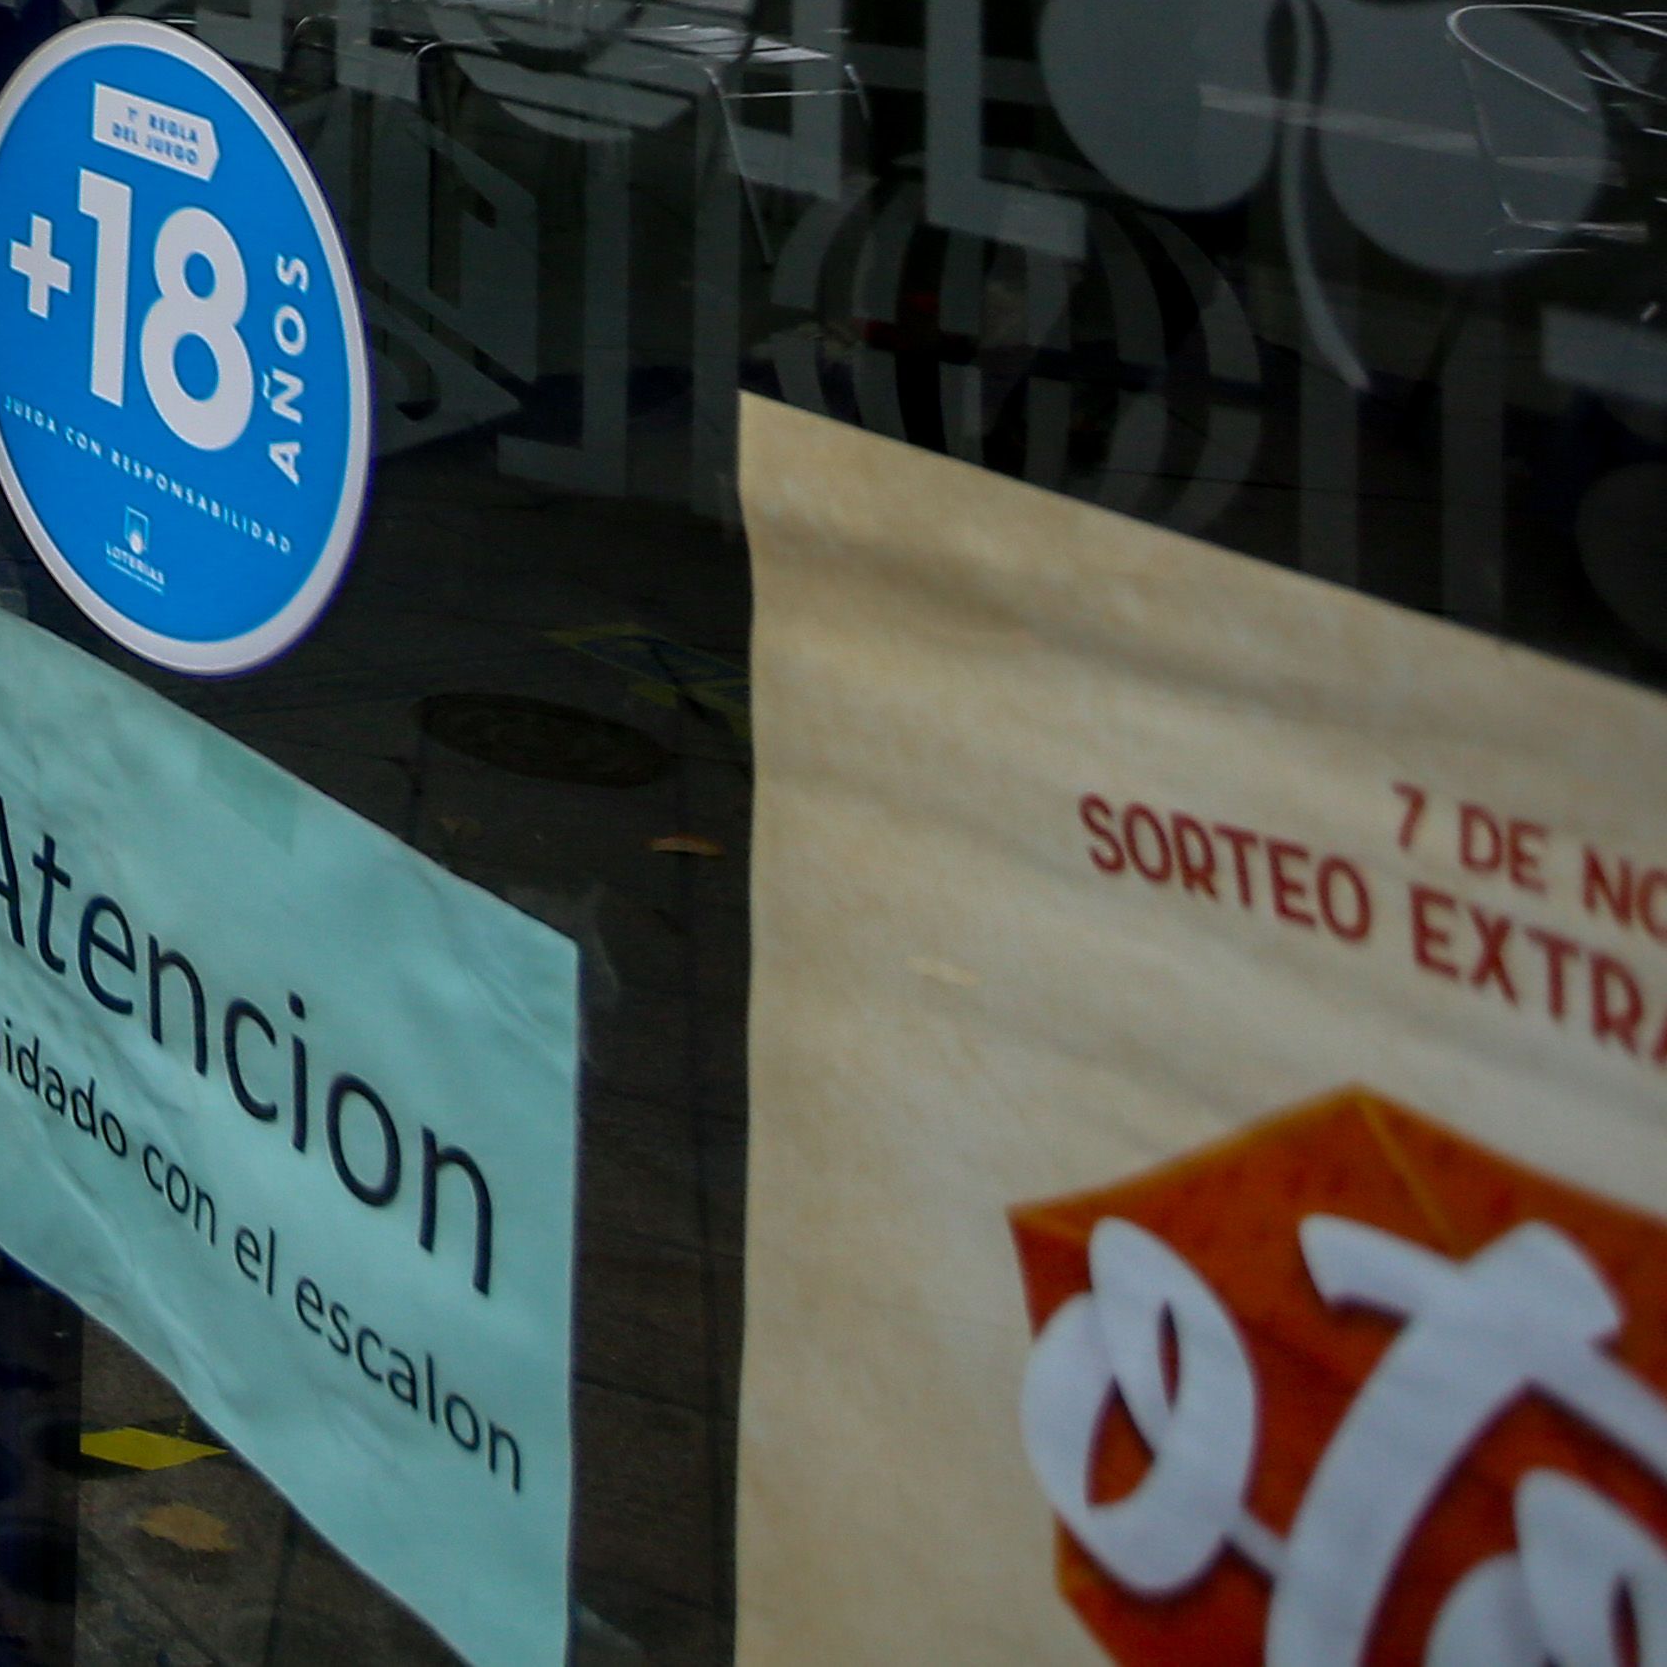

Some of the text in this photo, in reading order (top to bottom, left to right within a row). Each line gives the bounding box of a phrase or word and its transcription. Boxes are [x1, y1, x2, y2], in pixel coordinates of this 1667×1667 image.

[112, 121, 200, 166] DEL JUEGO
[148, 113, 199, 146] REGLA
[263, 252, 310, 486] AÑOS
[4, 395, 293, 555] JUEGA CON RESPONSABILIDAD
[1392, 782, 1429, 853] 7
[1458, 800, 1549, 897] DE
[1078, 792, 1667, 1070] SORTEO EXTR
[143, 1137, 218, 1247] con
[233, 1226, 277, 1297] el
[294, 1277, 524, 1495] escalon
